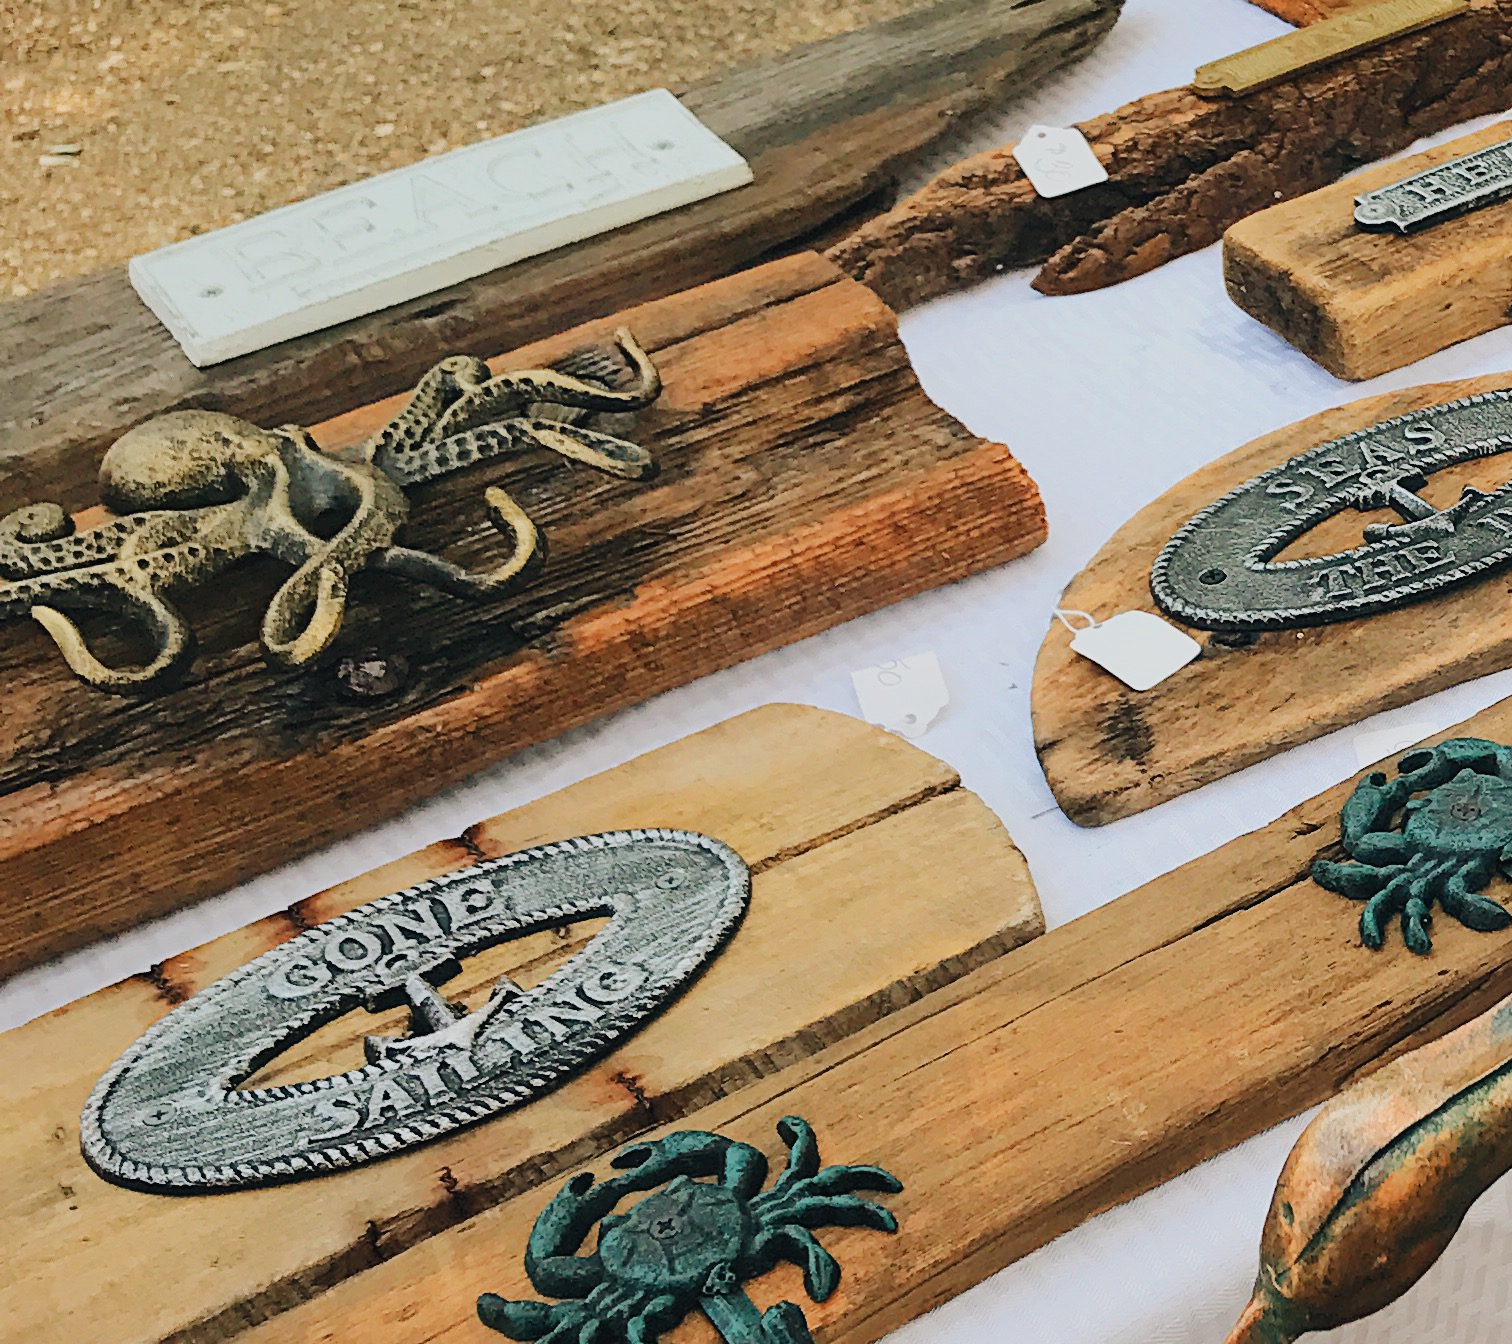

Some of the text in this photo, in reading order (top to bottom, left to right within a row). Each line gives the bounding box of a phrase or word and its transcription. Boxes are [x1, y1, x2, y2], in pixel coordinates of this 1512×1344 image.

[212, 120, 657, 292] BEACH
[1265, 420, 1447, 512] SEAS
[1312, 539, 1456, 598] THE
[267, 885, 500, 1000] GONE
[302, 960, 651, 1143] SAILING
